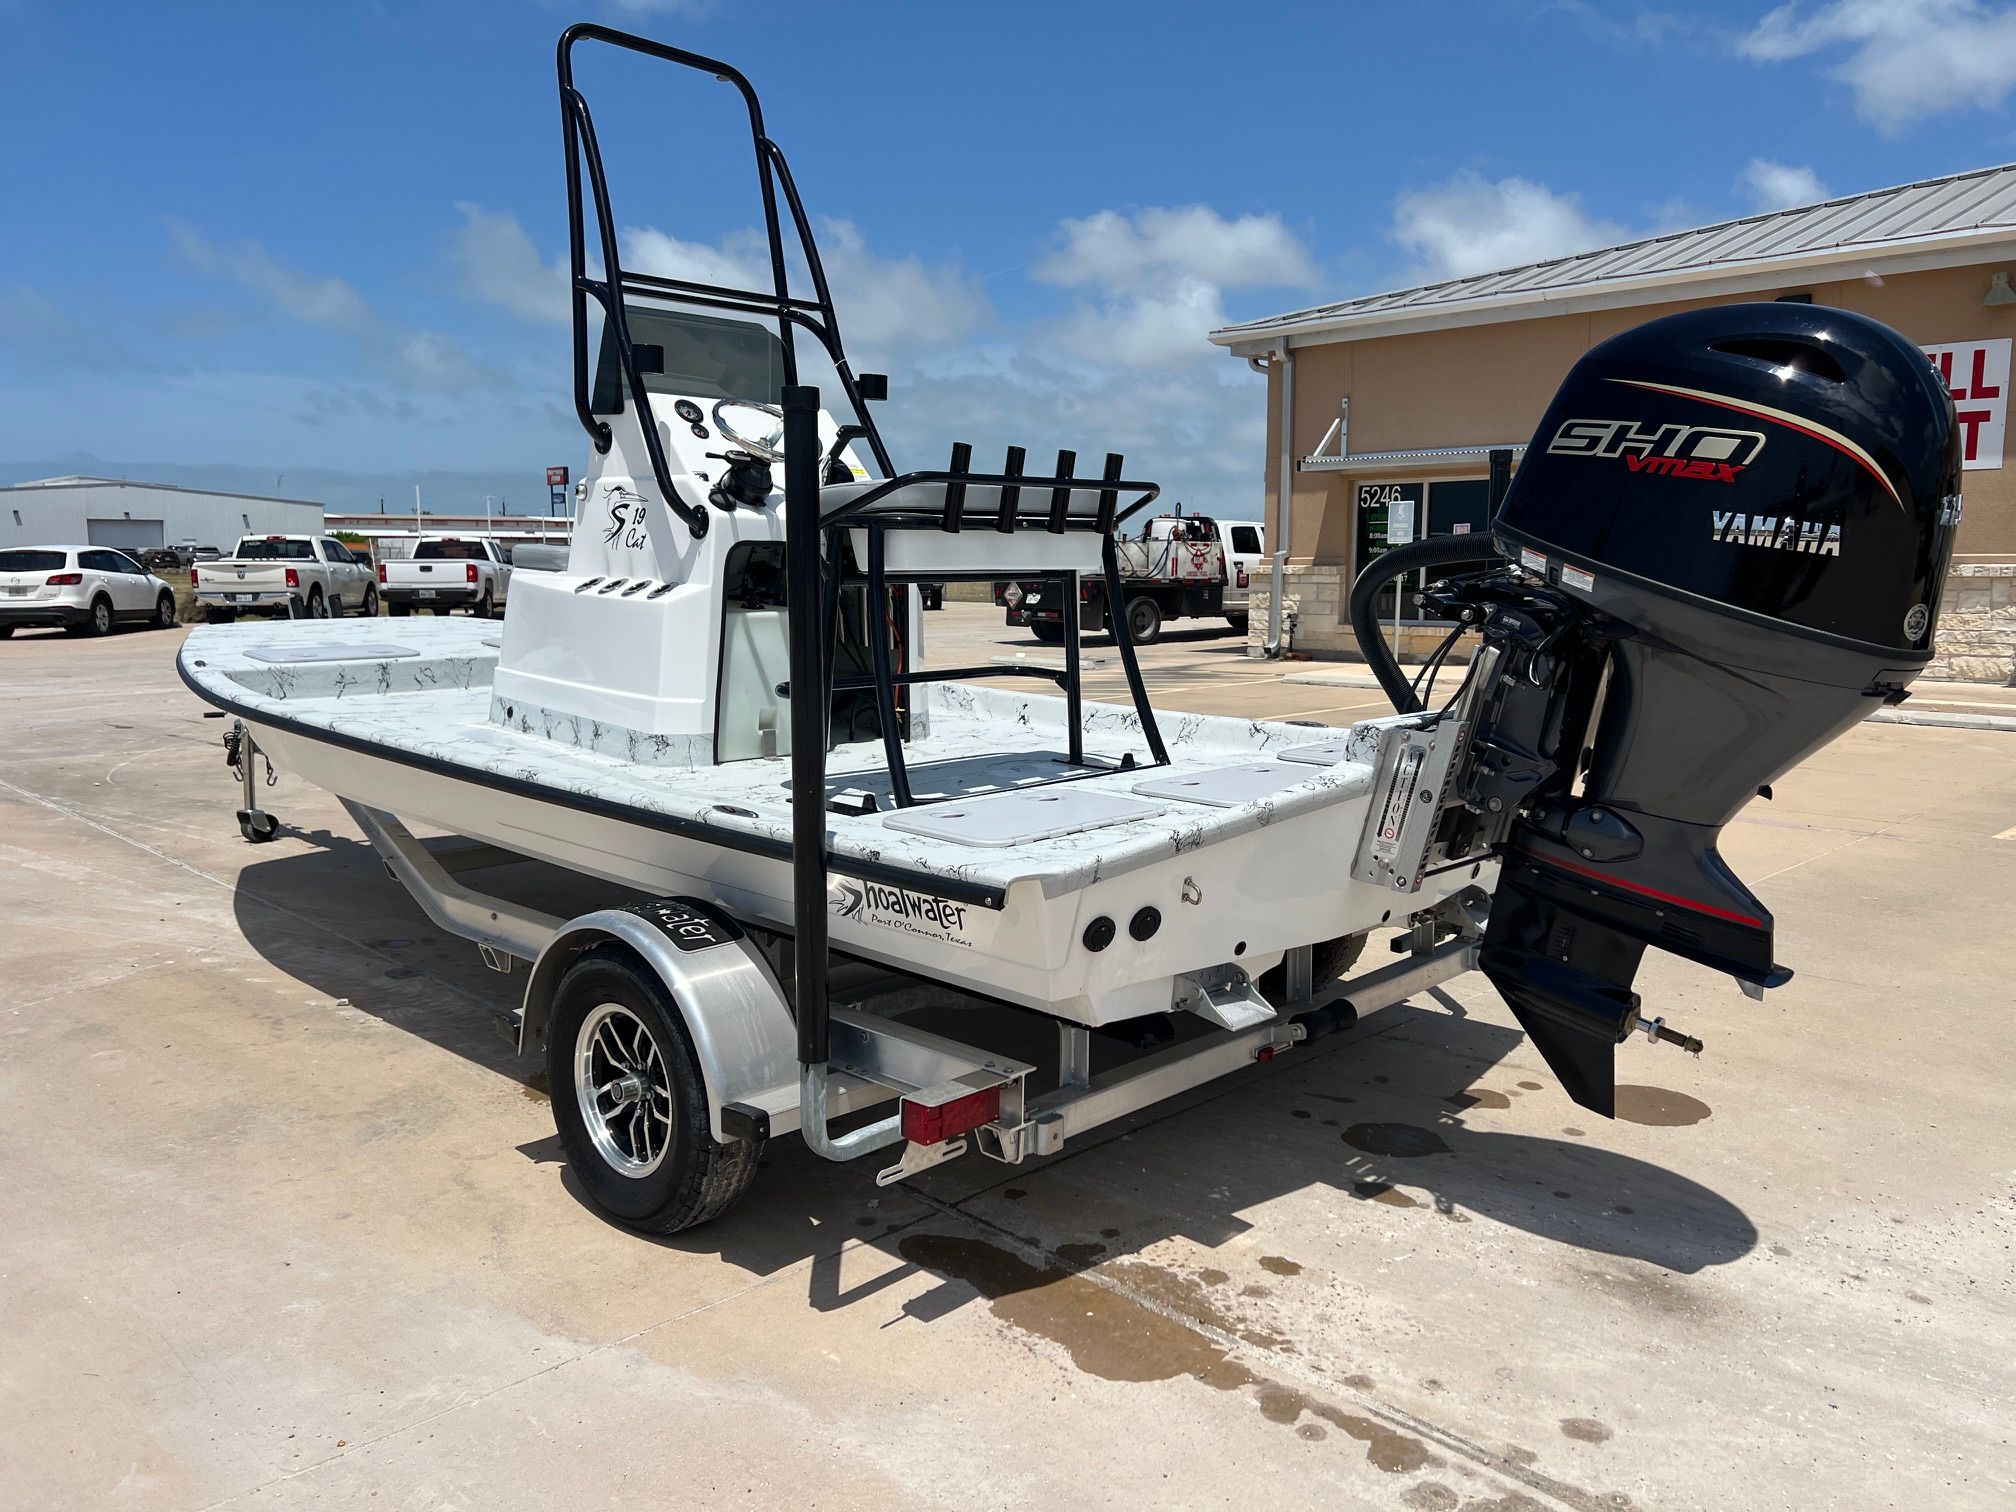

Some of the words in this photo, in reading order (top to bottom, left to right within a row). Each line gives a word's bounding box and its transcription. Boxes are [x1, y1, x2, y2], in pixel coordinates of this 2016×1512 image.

[1926, 349, 2000, 400] LL
[1547, 419, 1766, 464] SHO
[1360, 486, 1401, 508] 5246
[633, 507, 646, 525] 19
[625, 528, 647, 550] Cat
[1712, 510, 1840, 557] YAMAHA
[945, 932, 973, 947] Texas
